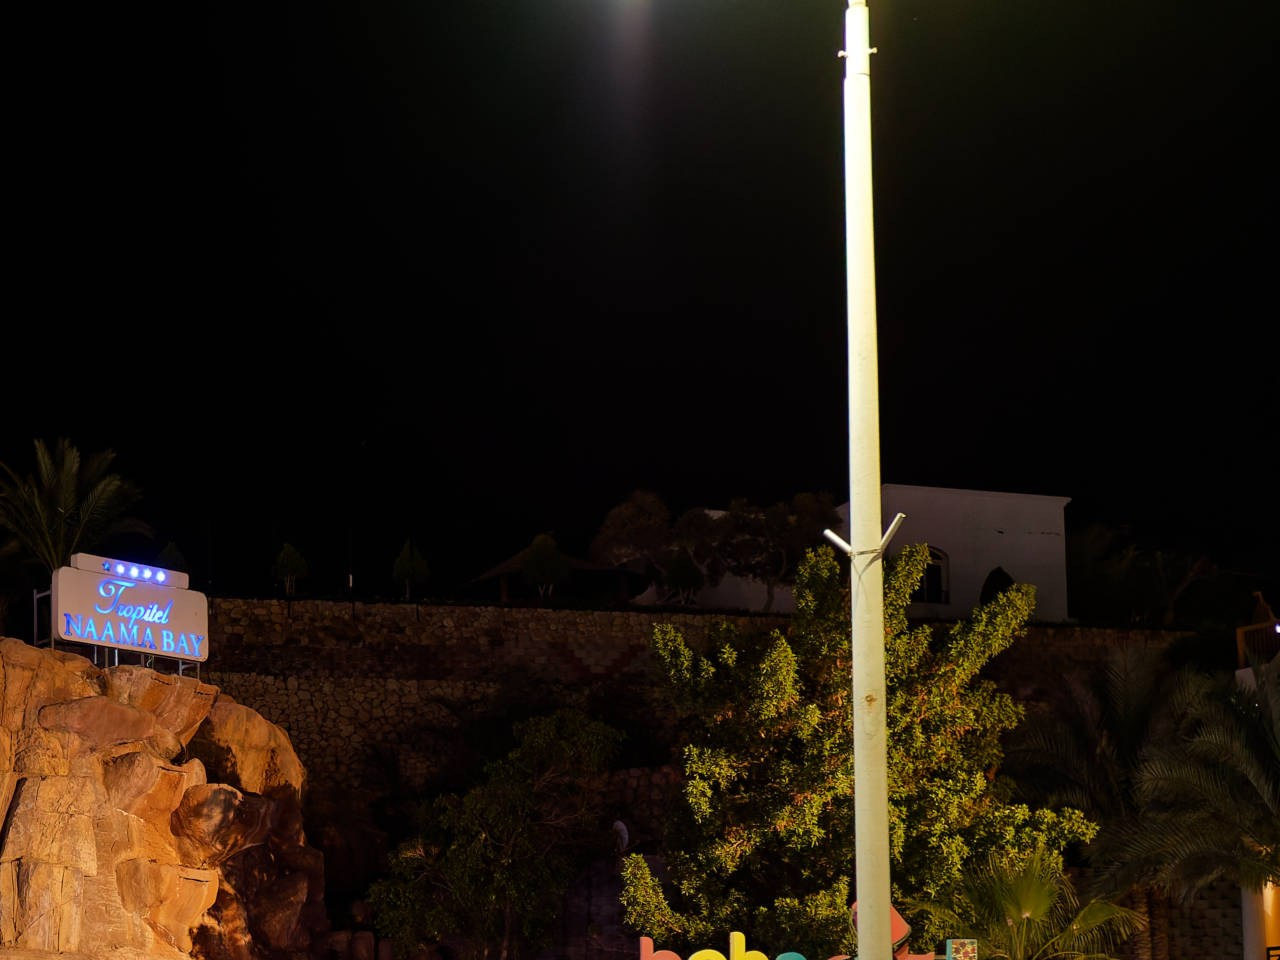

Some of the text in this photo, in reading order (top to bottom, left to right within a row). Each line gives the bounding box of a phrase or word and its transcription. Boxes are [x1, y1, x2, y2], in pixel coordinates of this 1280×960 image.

[94, 578, 173, 628] Tropitel
[63, 613, 205, 657] NAAMA BAY
